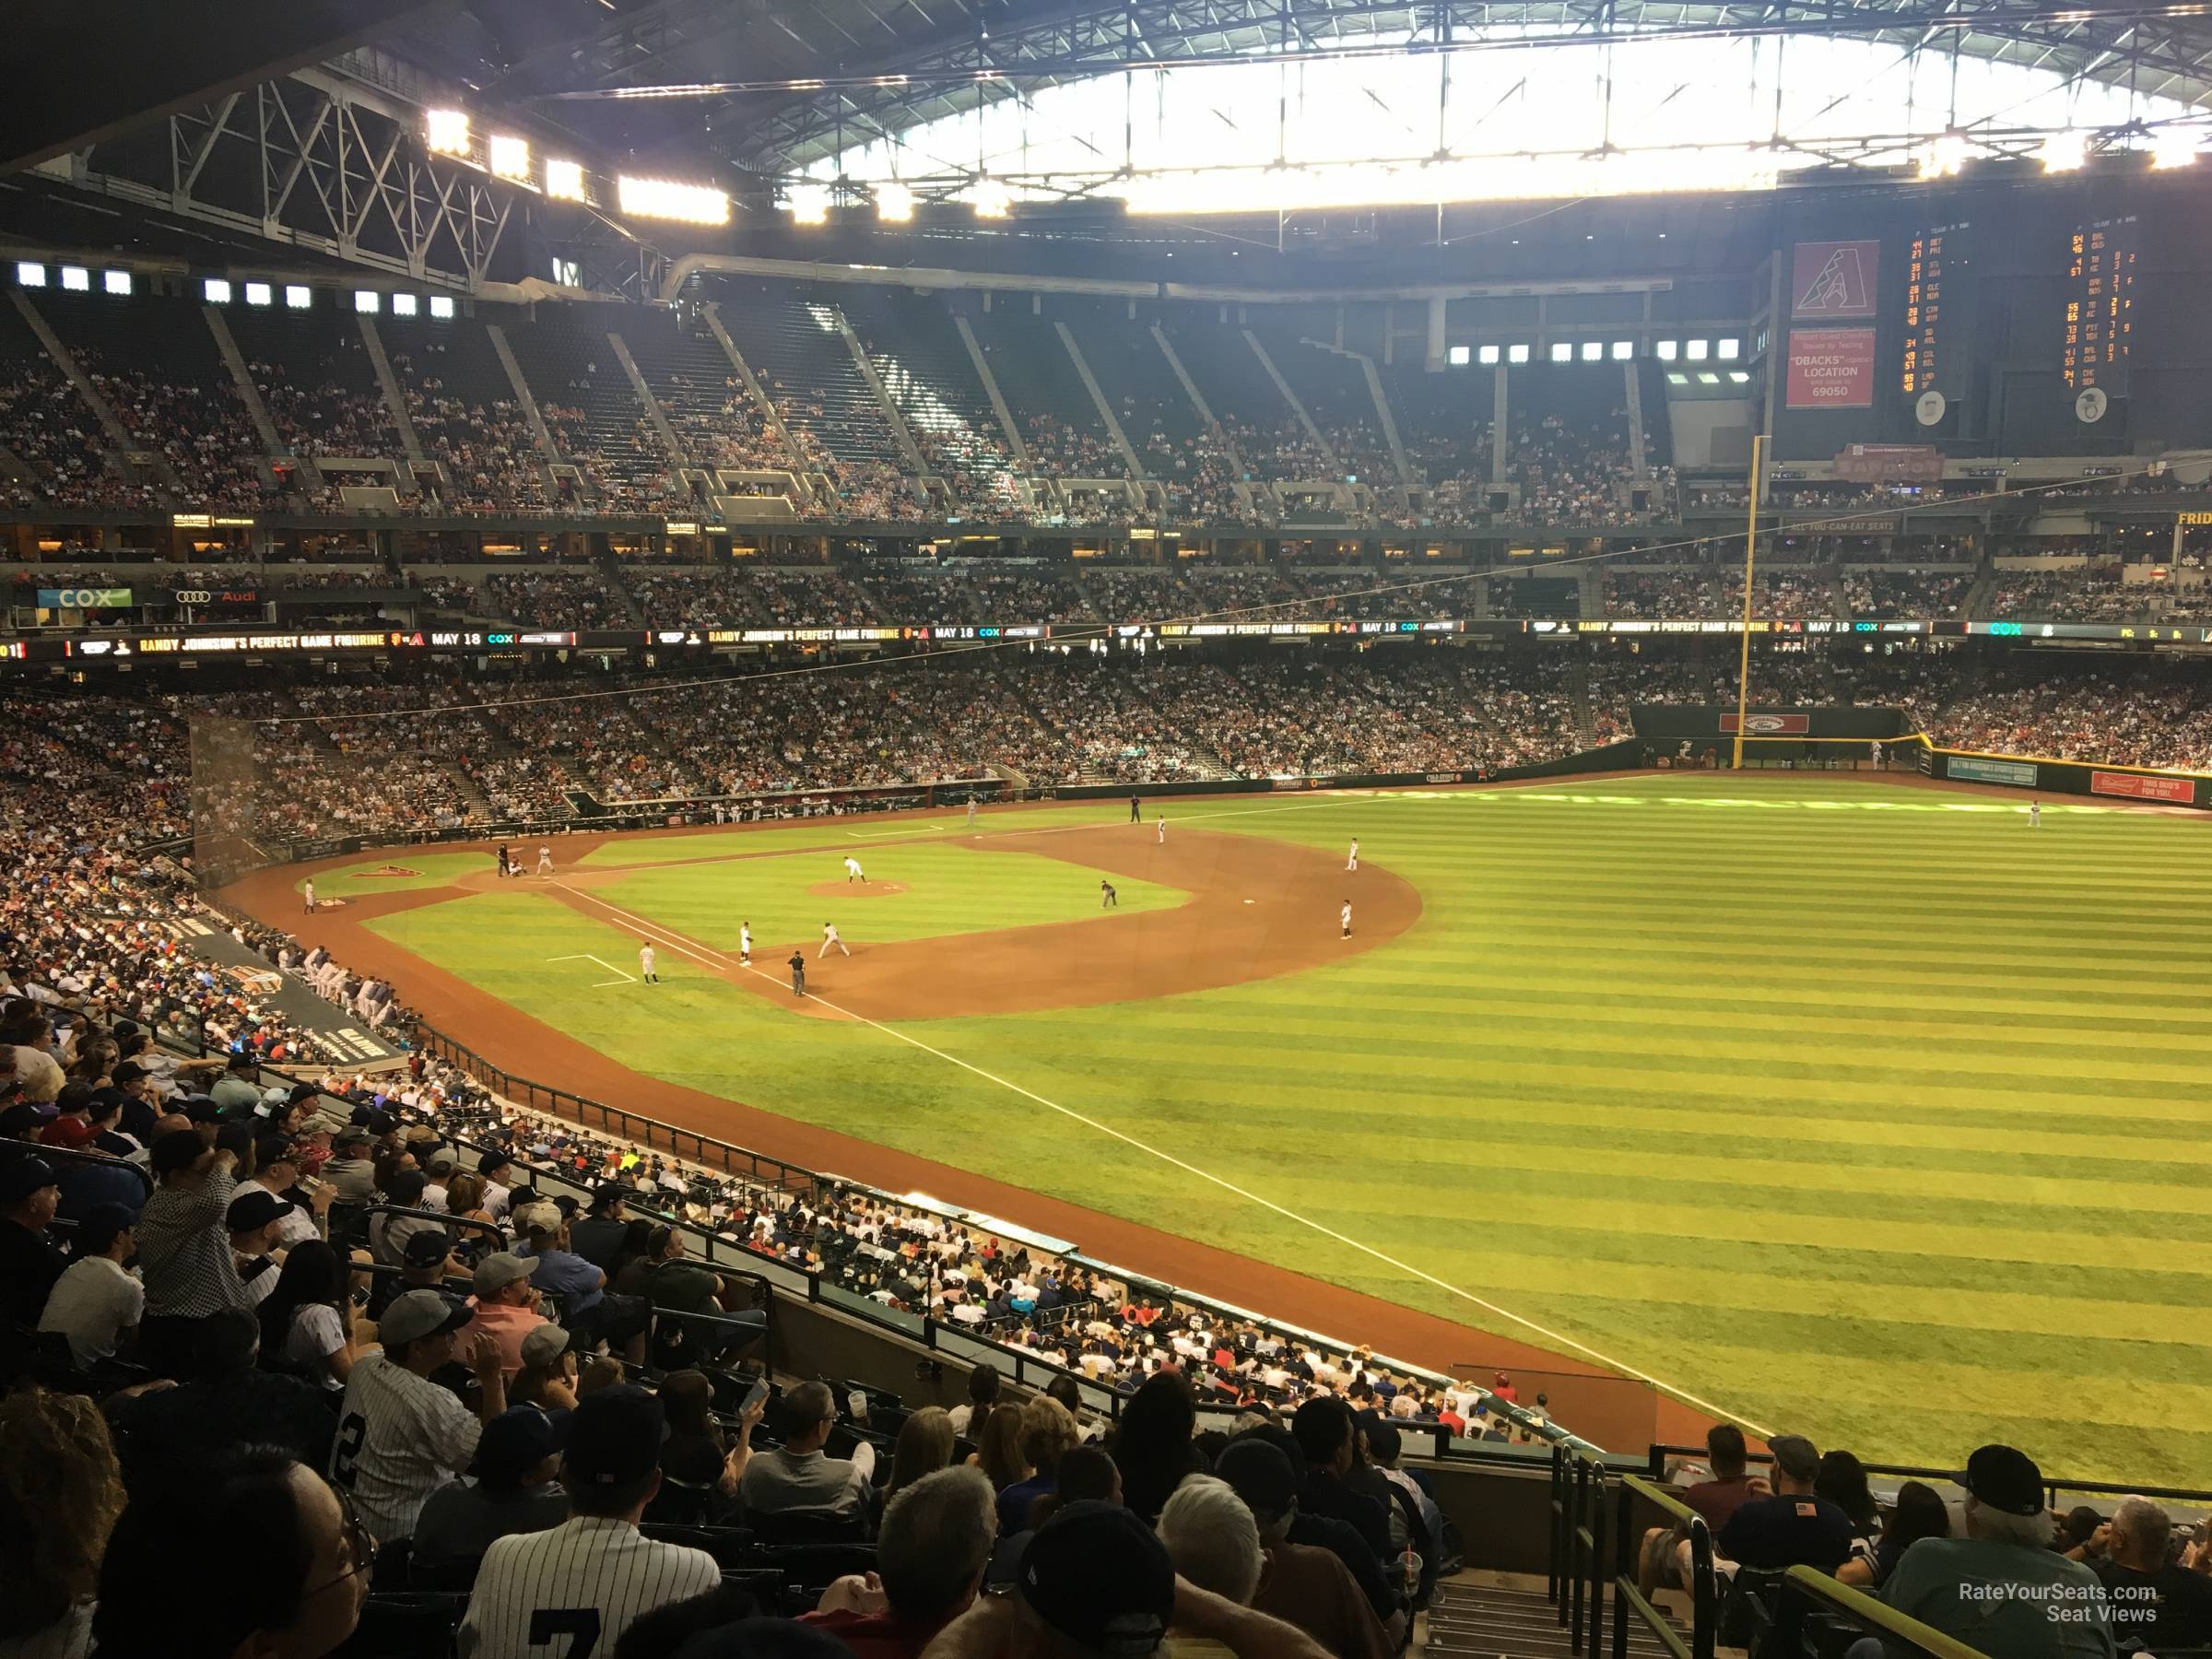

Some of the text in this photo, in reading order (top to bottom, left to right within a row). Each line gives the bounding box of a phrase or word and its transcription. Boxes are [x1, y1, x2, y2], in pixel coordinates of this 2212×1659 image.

[2129, 253, 2136, 263] 2
[1804, 367, 1858, 377] LOCATION
[1812, 386, 1849, 396] 69050
[1867, 522, 1894, 531] SEATS
[59, 590, 112, 607] COX
[221, 591, 256, 603] Audi
[1161, 625, 1189, 635] RANDY
[1236, 624, 1271, 634] PERFECT
[1272, 623, 1294, 634] GAME
[1294, 623, 1331, 633] FIGURINE
[1362, 622, 1397, 632] MAY 18
[1401, 623, 1419, 631] COX
[1579, 621, 1608, 631] RANDY
[1662, 621, 1701, 632] PERFECT
[1808, 621, 1850, 632] MAY 18
[1855, 622, 1878, 631] COX
[1989, 622, 2022, 636] COX
[709, 629, 900, 642] RANDY JOHNSON'S PERFECT GAME FIGURINE
[935, 628, 974, 638] MAY 18
[979, 628, 1000, 637] COX
[140, 633, 385, 652] RANDY JOHNSON'S PERFECT GAME FIGURINE
[432, 632, 481, 645] MAY 18
[488, 633, 513, 644] COX
[2142, 779, 2180, 790] THIS BUD'S
[2142, 787, 2155, 796] FOR
[333, 1412, 366, 1487] 2
[528, 1608, 601, 1659] 7
